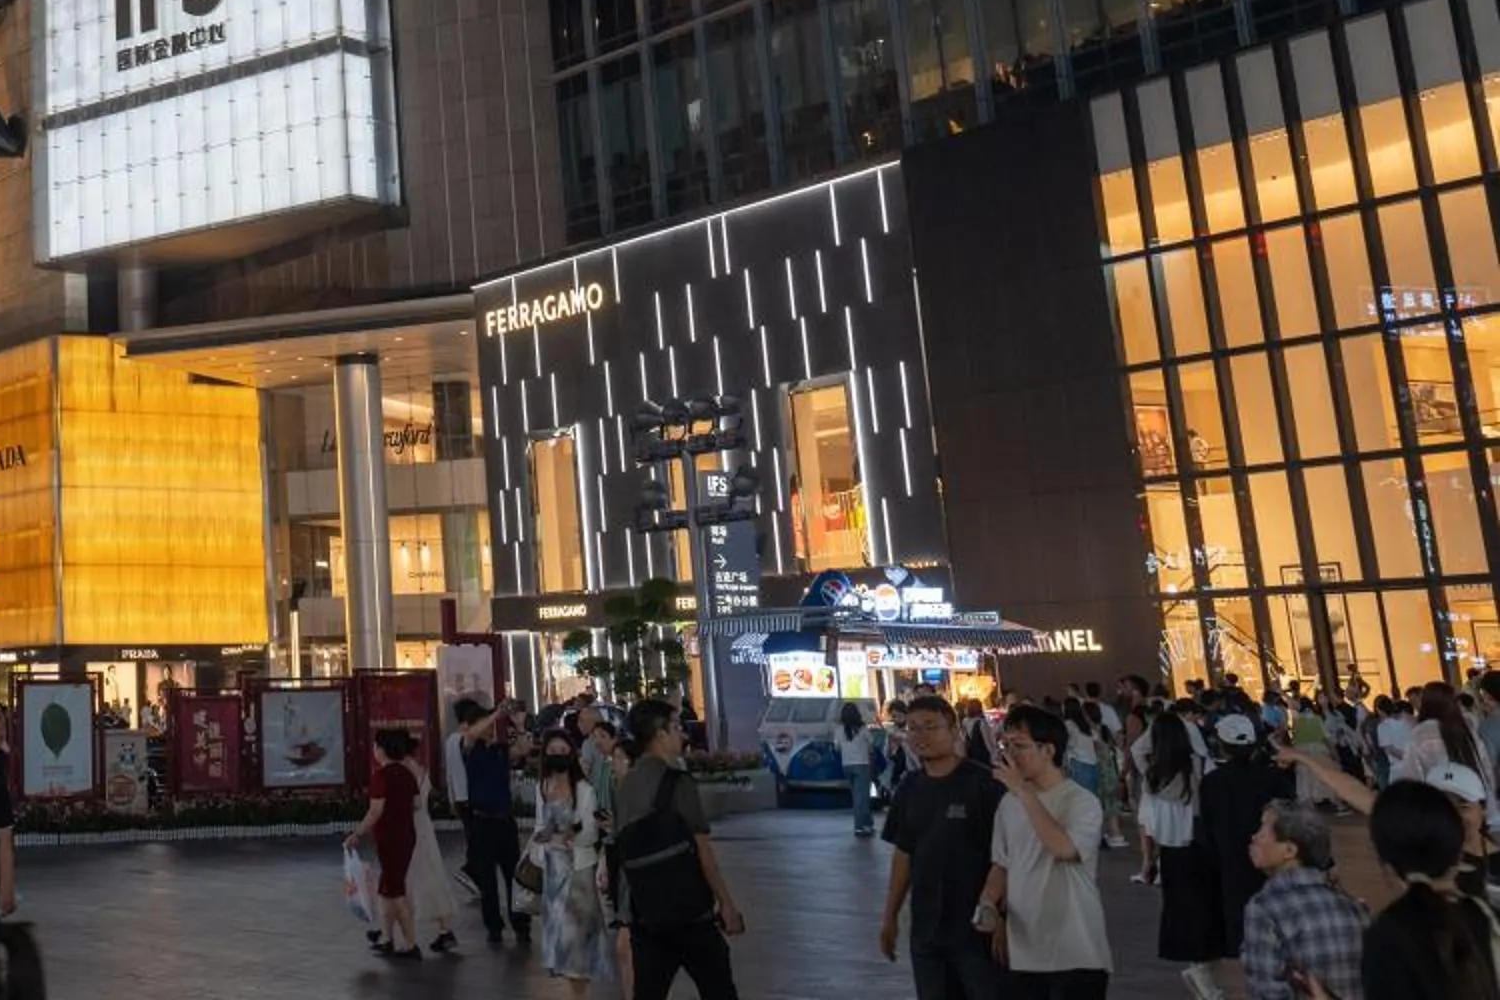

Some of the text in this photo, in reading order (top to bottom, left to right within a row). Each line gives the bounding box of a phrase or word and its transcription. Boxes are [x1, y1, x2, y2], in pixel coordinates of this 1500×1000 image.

[486, 283, 603, 337] FERRAGAMO
[707, 475, 728, 492] IFS
[539, 604, 587, 619] FERRAGAMO
[121, 649, 159, 659] PRADA
